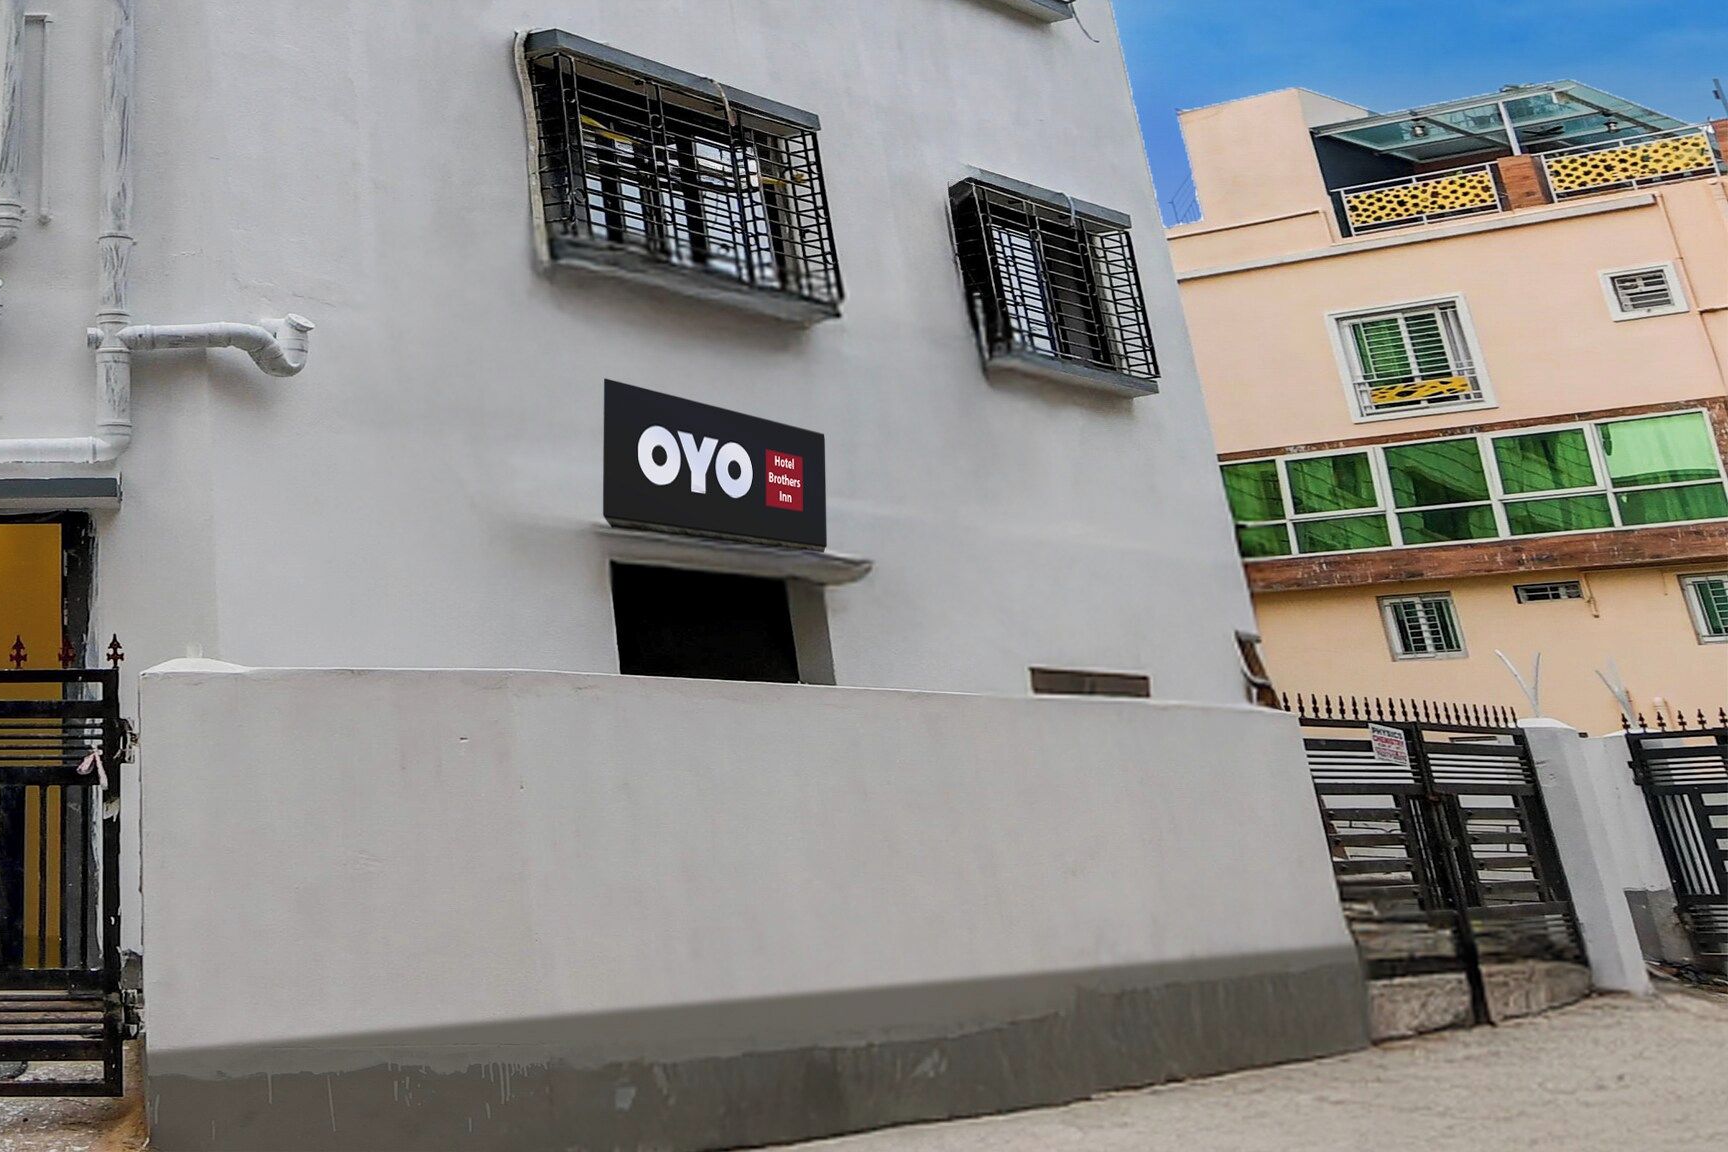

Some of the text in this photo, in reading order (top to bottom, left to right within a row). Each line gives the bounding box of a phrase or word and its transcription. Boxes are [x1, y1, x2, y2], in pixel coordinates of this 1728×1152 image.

[637, 425, 753, 498] OYO
[774, 455, 795, 469] Hotel
[768, 471, 801, 488] Brothers
[779, 490, 792, 503] Inn
